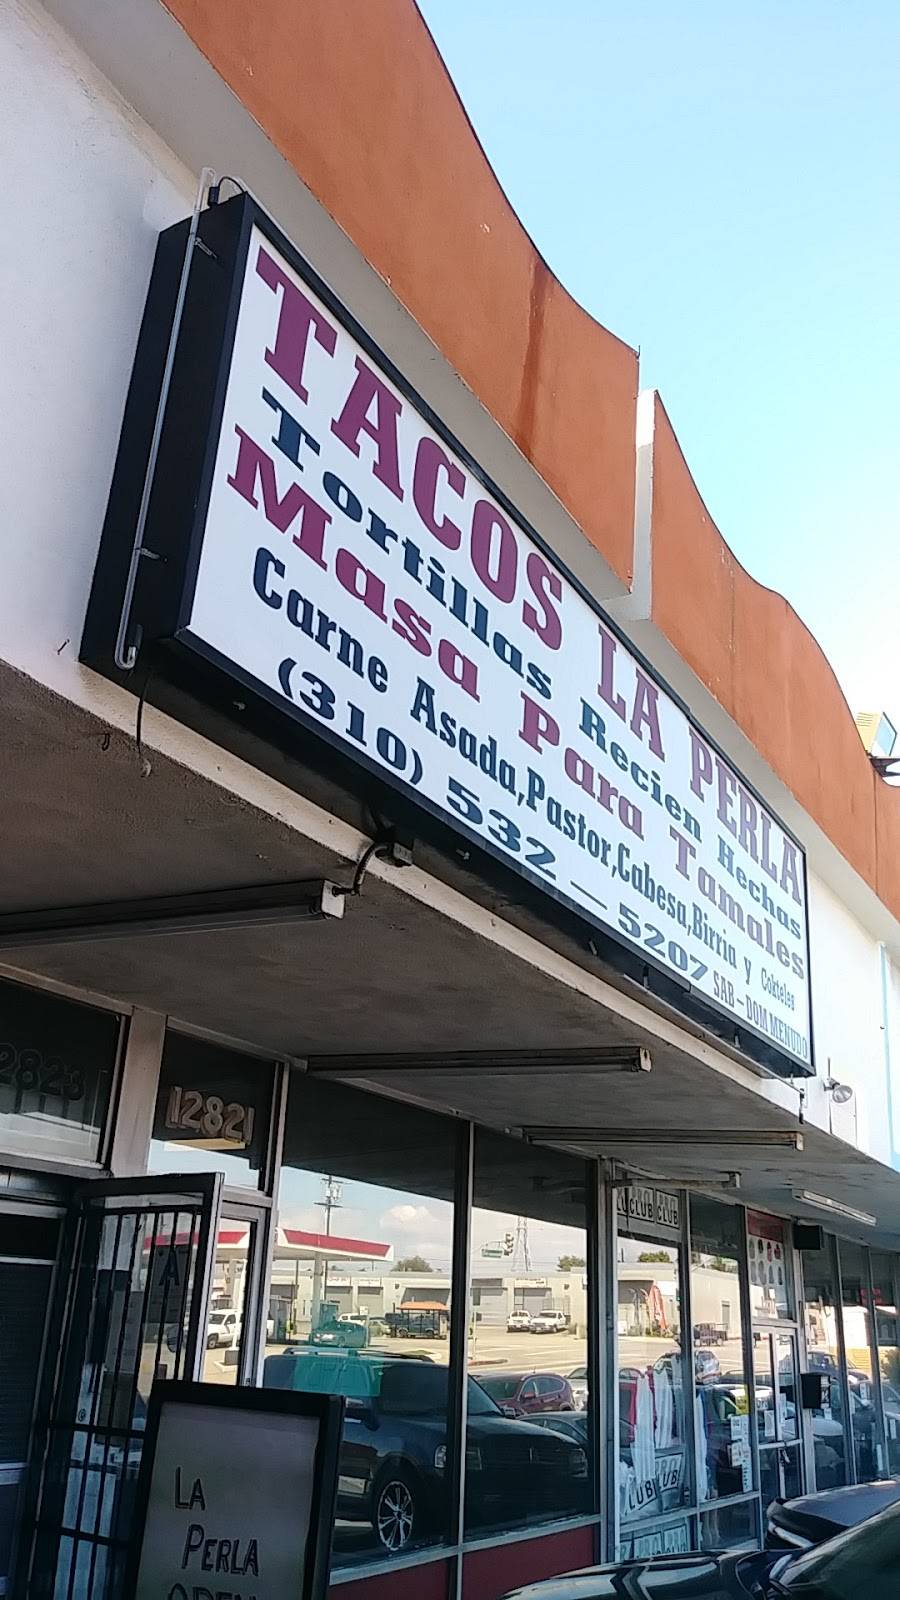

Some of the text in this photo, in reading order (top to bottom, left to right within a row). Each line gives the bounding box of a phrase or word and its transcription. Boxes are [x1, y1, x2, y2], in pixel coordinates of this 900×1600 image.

[255, 245, 802, 907] TACOS LA PERLA
[261, 386, 802, 940] Tortillas Recien Hechas
[226, 423, 804, 980] Masa Para Tamales
[253, 546, 389, 694] Carne
[744, 956, 752, 985] y
[278, 657, 423, 785] (310)
[446, 775, 556, 880] 532
[618, 901, 709, 981] 5207
[769, 1012, 808, 1059] MENUDO
[167, 1085, 256, 1146] 12821
[629, 1198, 653, 1218] CLUB
[657, 1205, 678, 1225] CLUB
[174, 1466, 206, 1511] LA
[181, 1522, 259, 1577] PERLA
